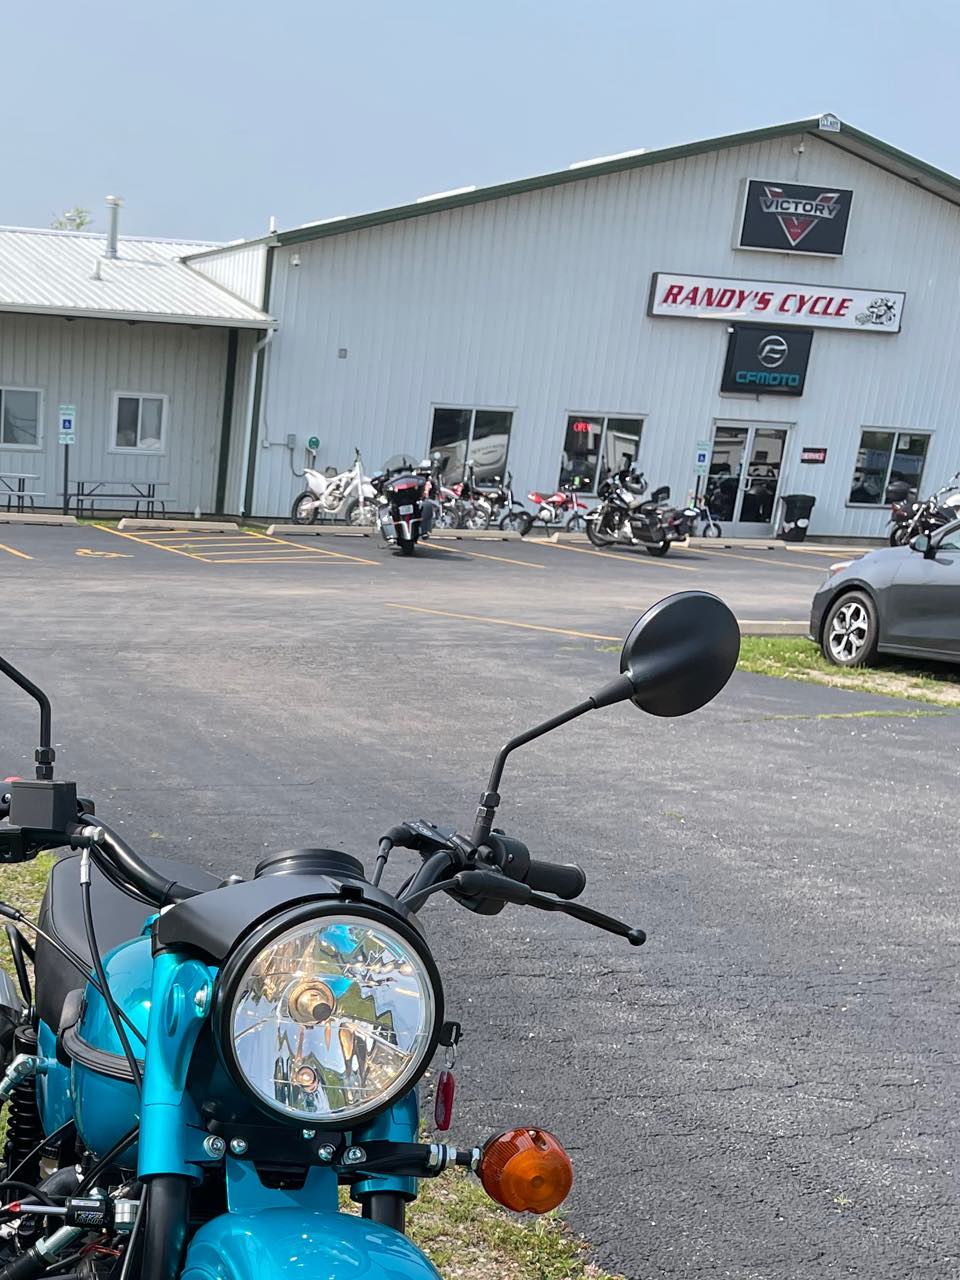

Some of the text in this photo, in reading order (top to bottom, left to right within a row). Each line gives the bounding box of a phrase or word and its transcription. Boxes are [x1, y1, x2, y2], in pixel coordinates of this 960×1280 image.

[762, 199, 837, 216] VICTORY
[662, 285, 853, 317] RANDY'S CYCLE
[736, 371, 800, 386] CFMOTO
